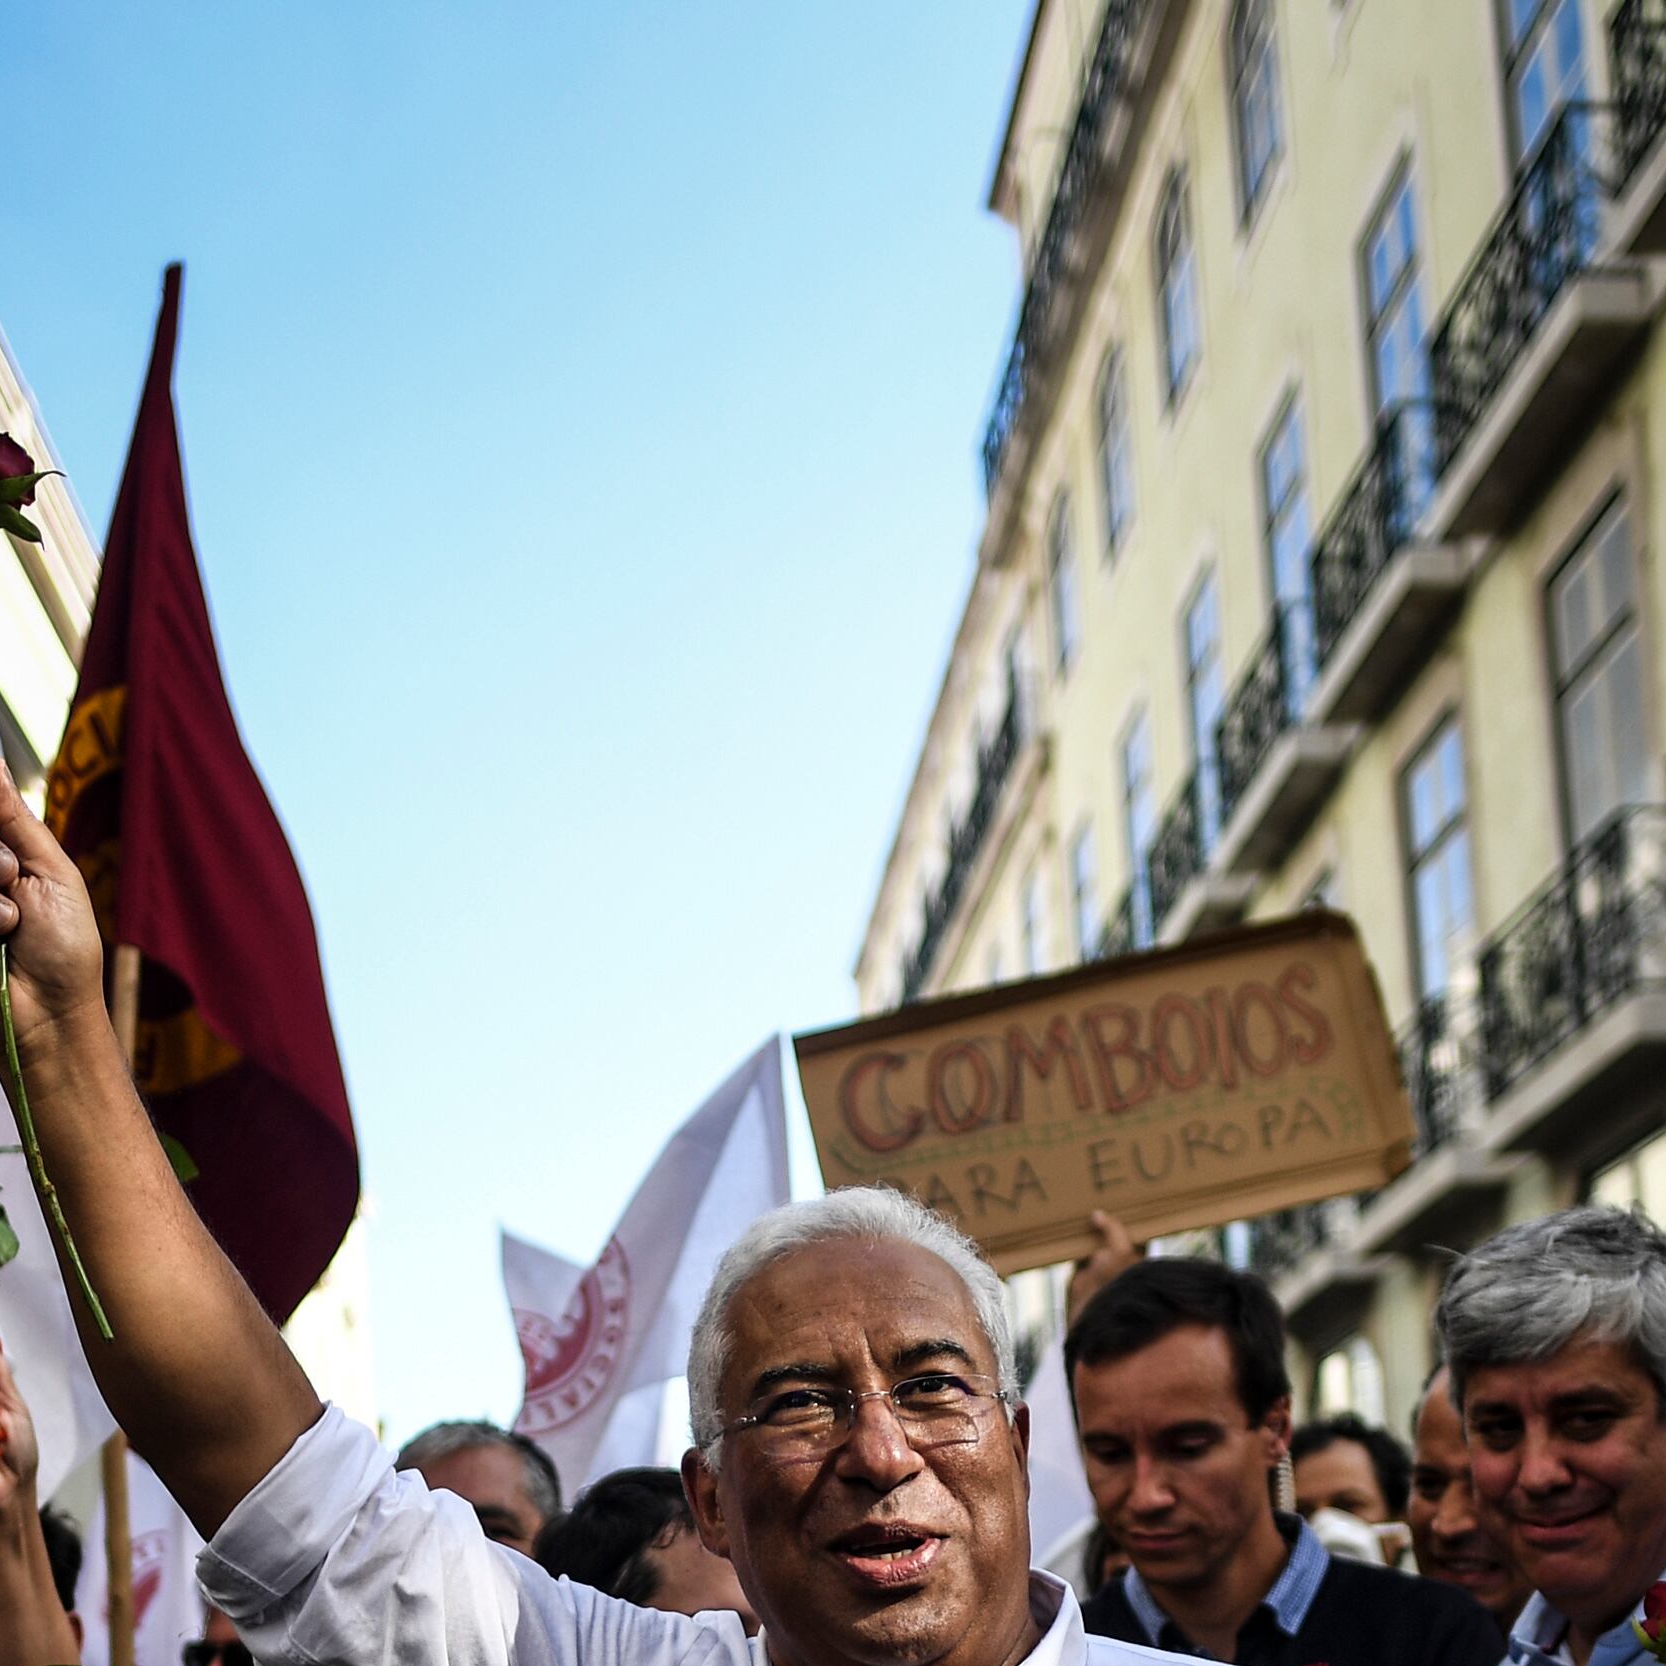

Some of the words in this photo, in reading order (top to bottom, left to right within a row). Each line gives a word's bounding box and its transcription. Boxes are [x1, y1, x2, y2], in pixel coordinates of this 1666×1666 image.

[838, 962, 1333, 1153] COMBOIOS
[883, 1157, 1050, 1220] ARA
[1086, 1098, 1331, 1193] EUROPA
